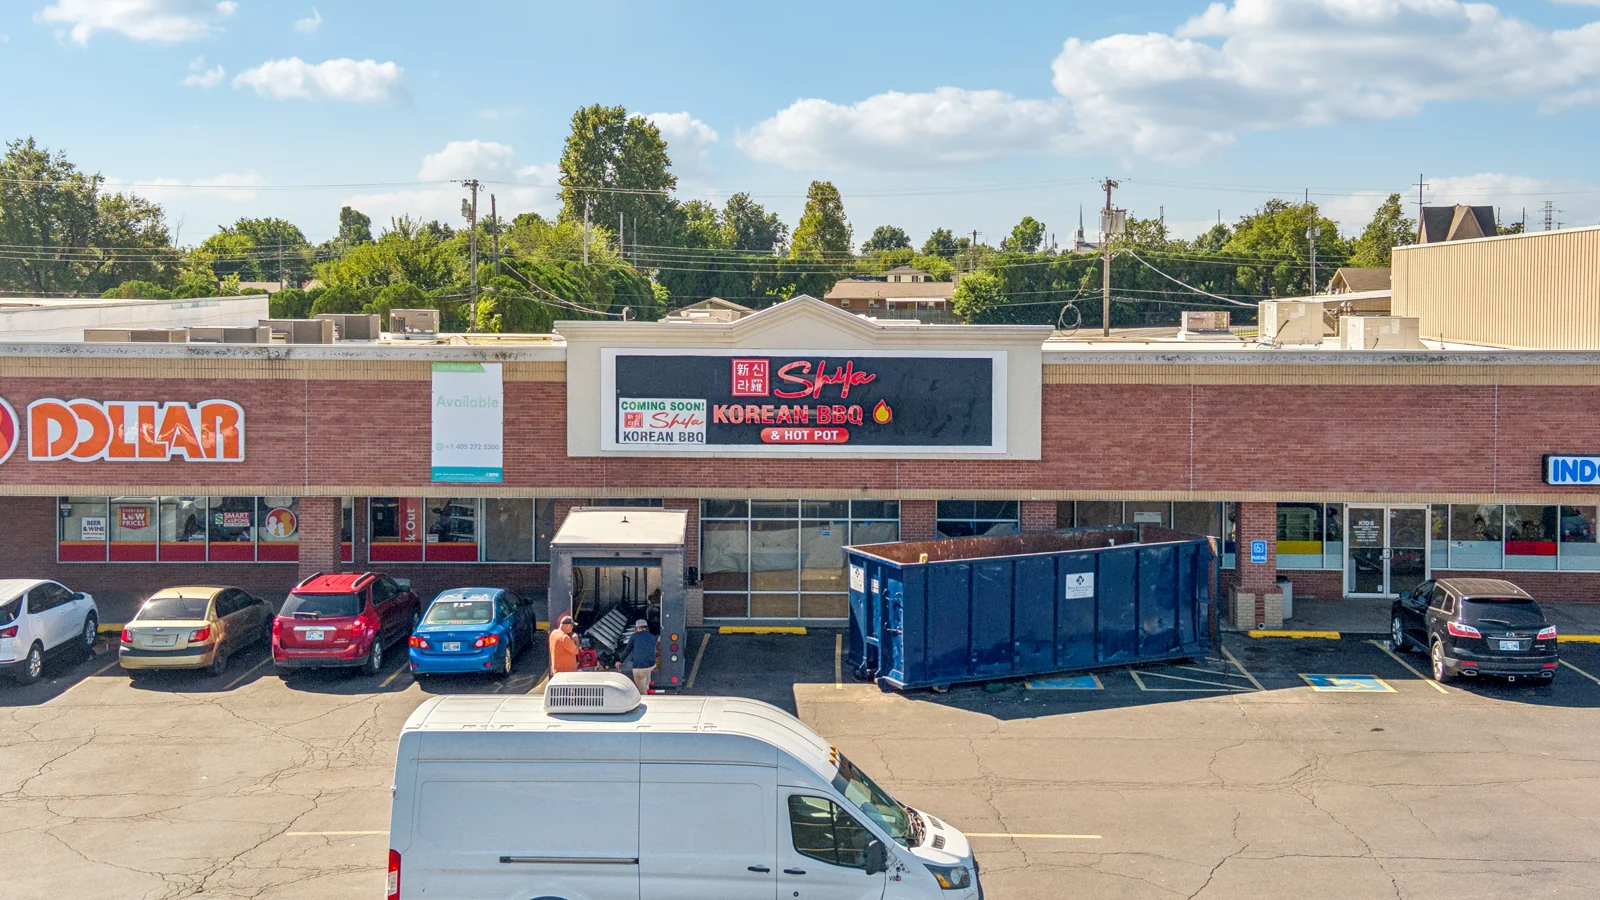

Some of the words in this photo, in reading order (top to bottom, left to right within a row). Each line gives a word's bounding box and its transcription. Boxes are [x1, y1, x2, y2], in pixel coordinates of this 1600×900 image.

[774, 360, 876, 398] Shila
[436, 395, 499, 408] Available
[621, 401, 666, 410] COMING
[670, 402, 705, 411] SOON!
[649, 412, 704, 428] Shila
[713, 404, 809, 424] KOREAN
[816, 405, 864, 426] BBQ
[30, 401, 242, 459] DOLLAR
[623, 431, 674, 442] KOREAN
[679, 432, 704, 443] BBQ
[770, 431, 780, 440] &
[784, 430, 810, 440] HOT
[814, 430, 839, 440] POT
[1553, 459, 1600, 482] IND
[406, 508, 416, 531] Out
